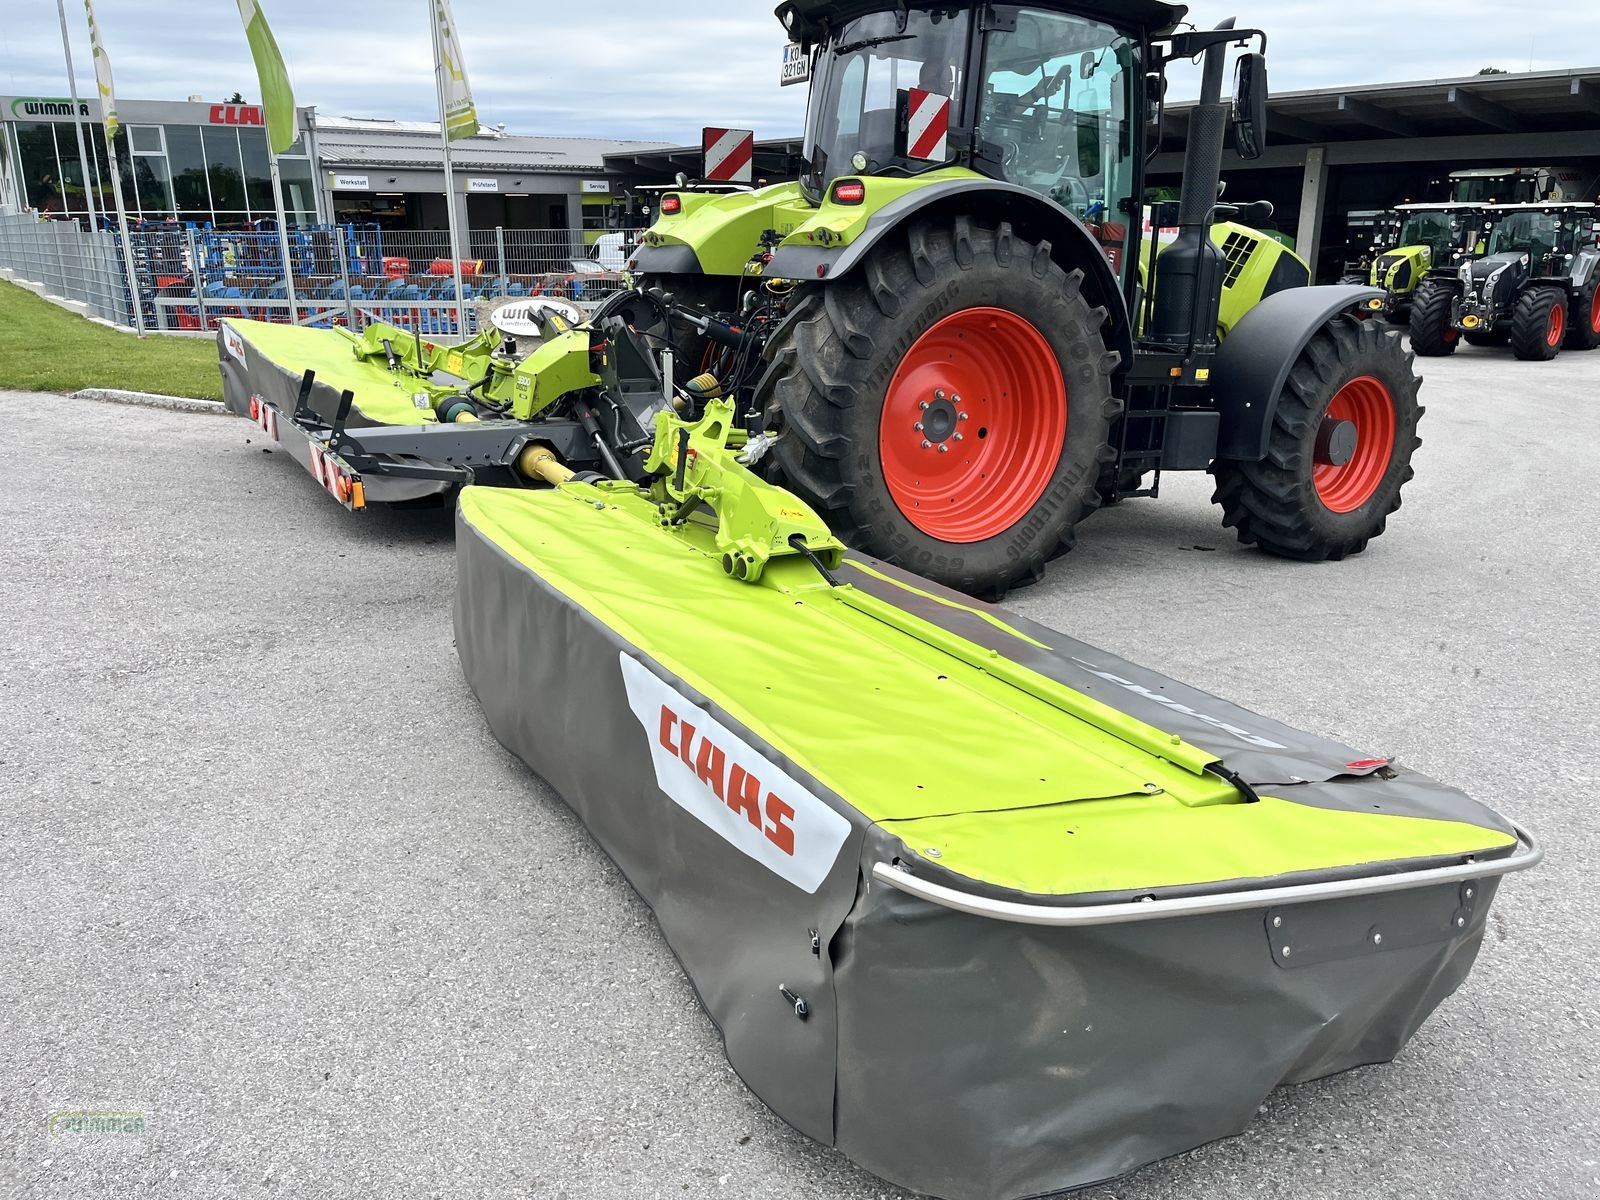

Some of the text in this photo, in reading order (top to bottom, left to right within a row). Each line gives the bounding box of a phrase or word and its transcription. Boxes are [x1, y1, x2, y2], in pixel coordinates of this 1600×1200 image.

[783, 60, 806, 77] 321GN
[209, 105, 265, 125] CLA
[1006, 462, 1089, 560] TRELLEBORG
[659, 703, 796, 857] CLAAS
